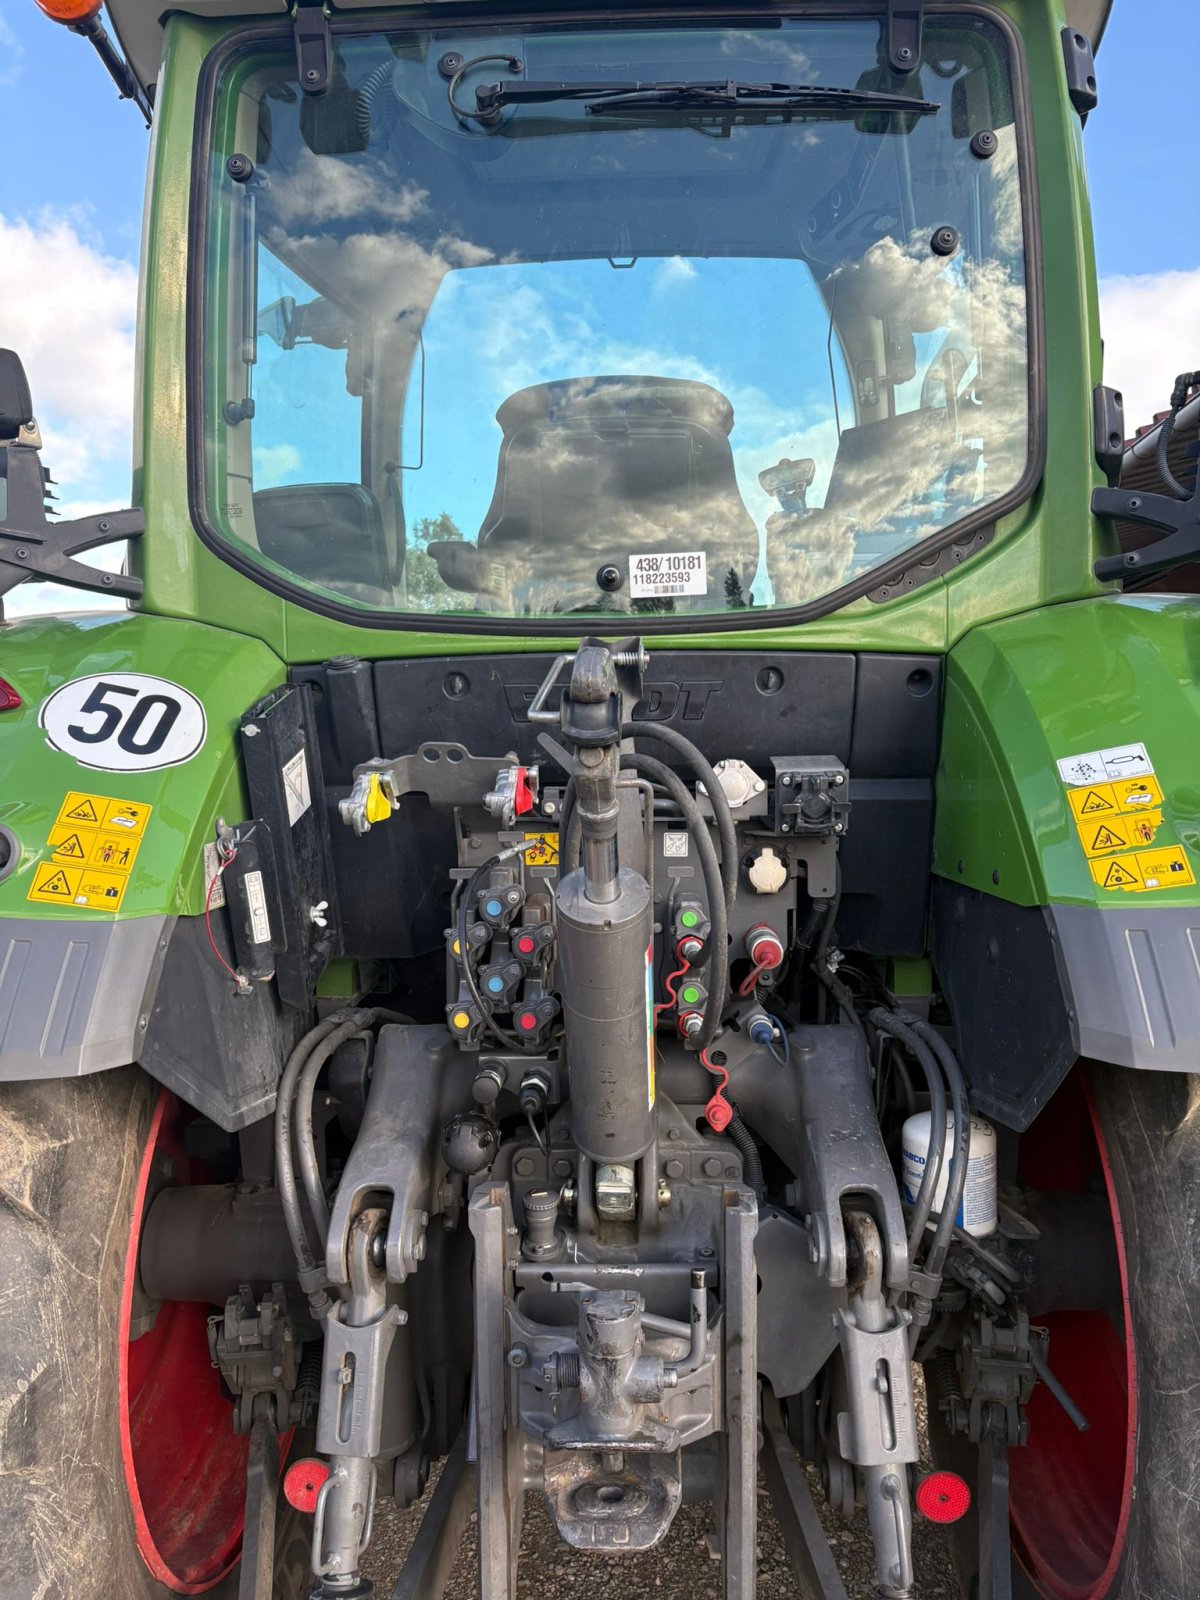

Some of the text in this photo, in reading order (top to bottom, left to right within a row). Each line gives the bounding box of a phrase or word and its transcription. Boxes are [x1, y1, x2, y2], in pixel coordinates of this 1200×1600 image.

[633, 572, 691, 585] 118223593
[67, 681, 182, 755] 50
[503, 680, 725, 723] FDT
